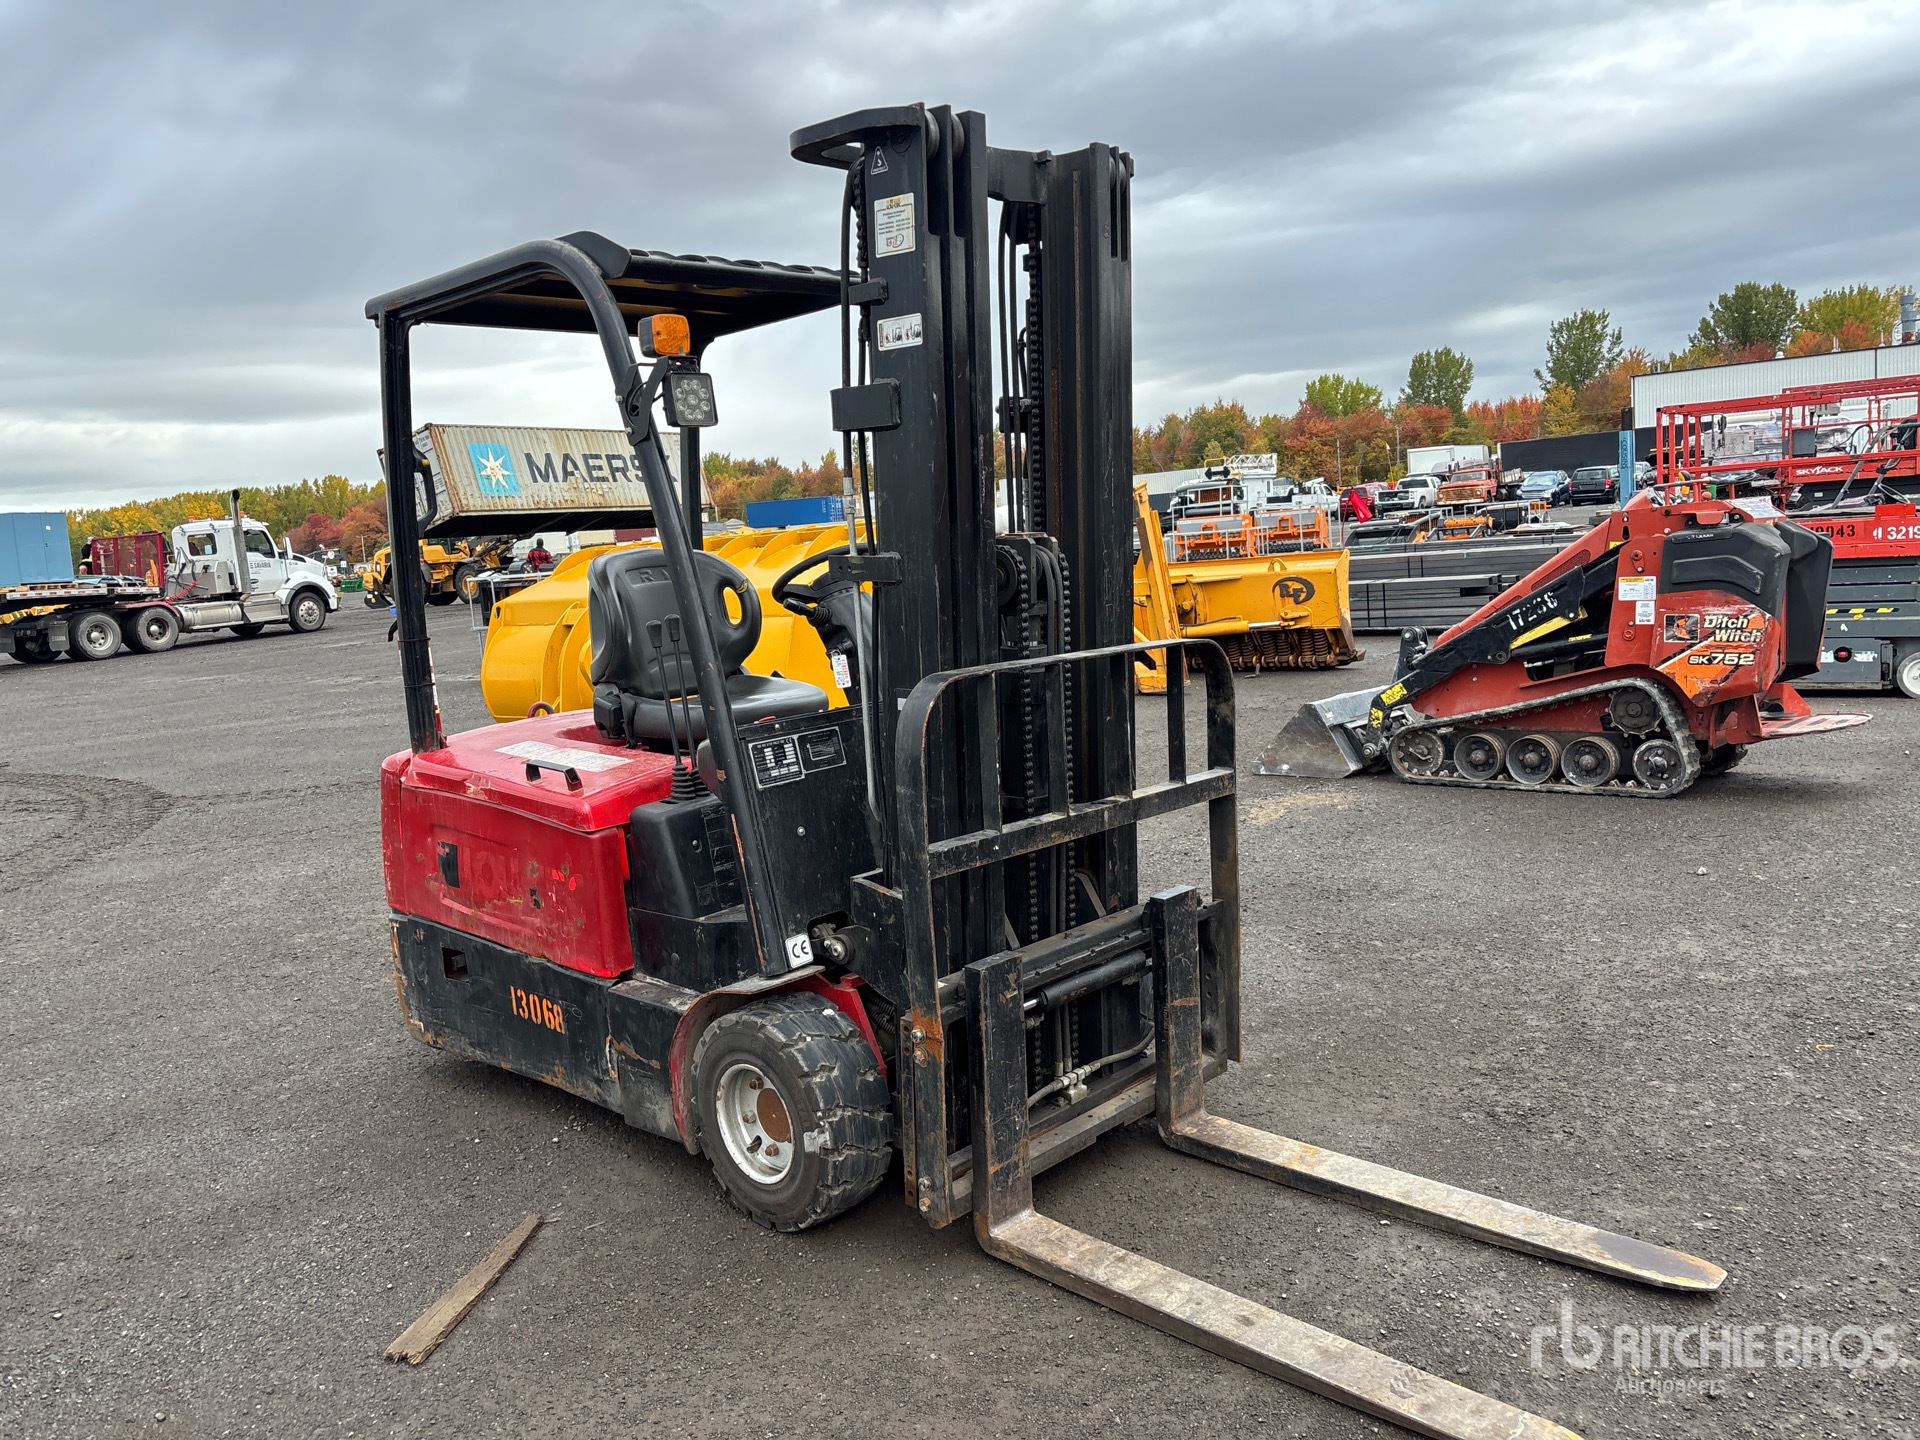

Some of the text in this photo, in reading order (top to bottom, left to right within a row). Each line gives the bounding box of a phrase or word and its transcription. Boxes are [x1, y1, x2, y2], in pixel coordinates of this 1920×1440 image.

[524, 452, 678, 484] MAERS
[1796, 465, 1843, 475] SKYJACK
[1703, 615, 1748, 628] Ditch
[1715, 629, 1761, 642] Witch
[1689, 653, 1754, 665] SK752
[510, 985, 566, 1035] 13068
